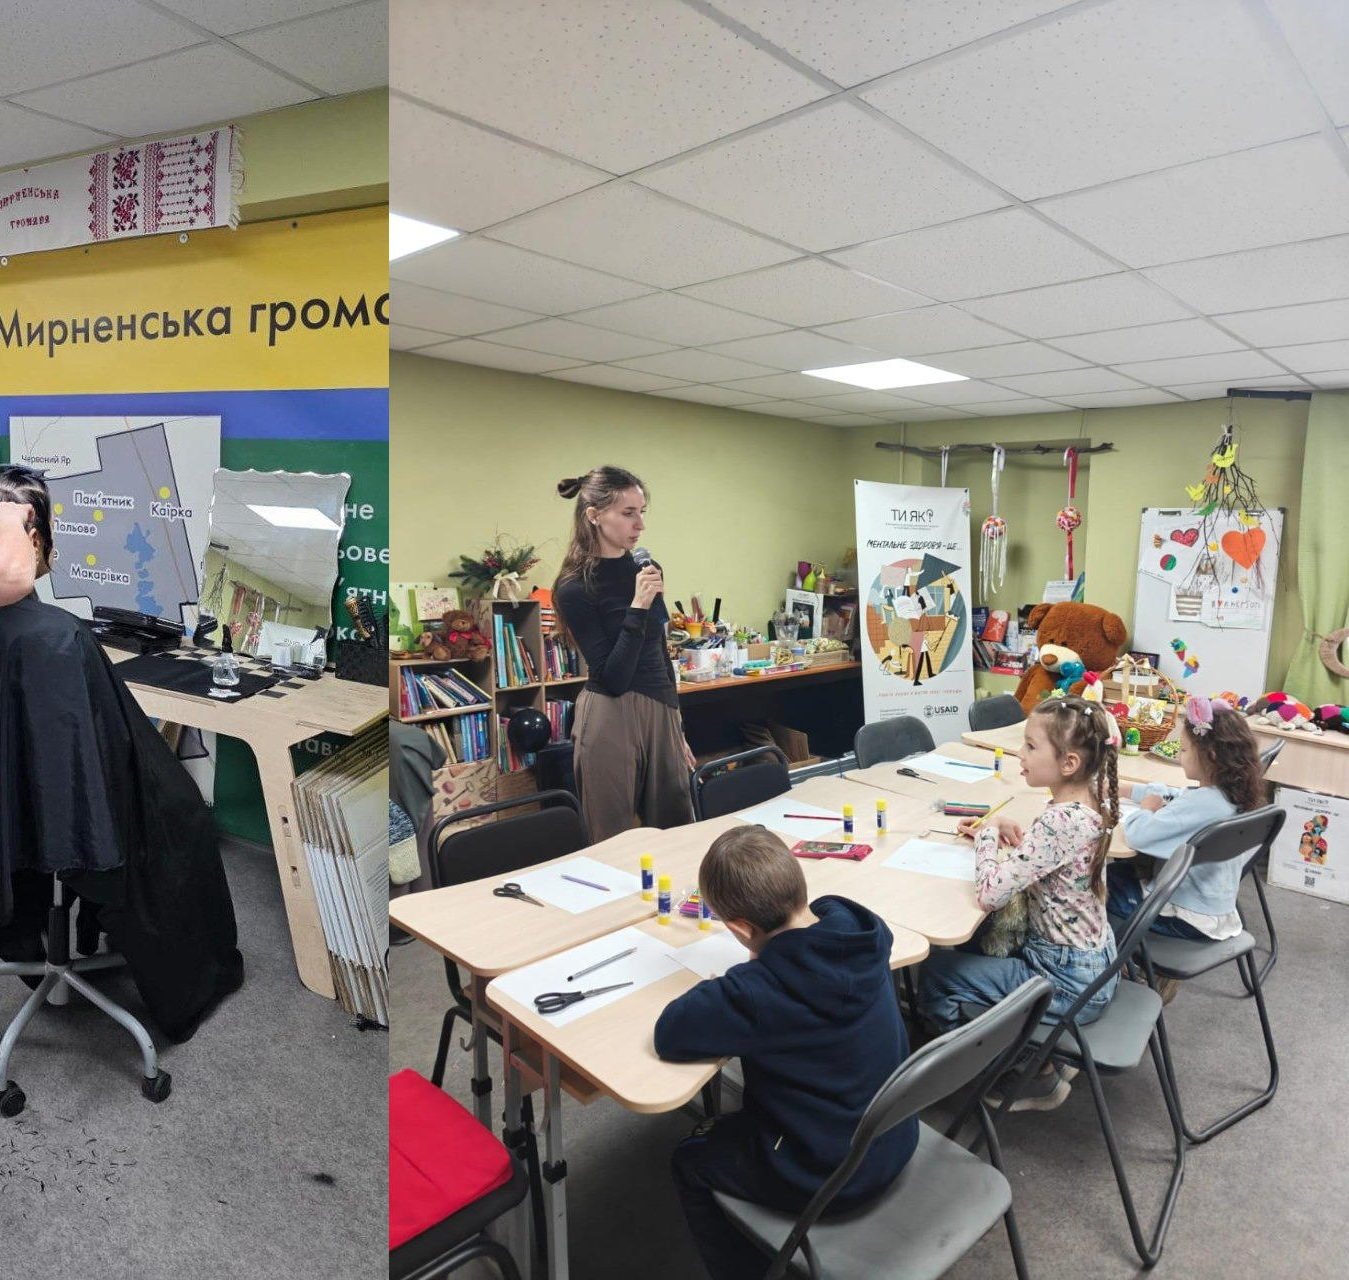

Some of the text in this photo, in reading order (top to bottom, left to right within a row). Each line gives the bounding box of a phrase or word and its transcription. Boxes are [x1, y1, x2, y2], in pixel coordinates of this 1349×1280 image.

[60, 455, 71, 465] Яр
[151, 503, 193, 520] Каїрка
[890, 508, 934, 523] ТИ ЯК?
[867, 539, 907, 550] МЕНТАЛЬНЕ
[71, 565, 129, 583] Макарівка
[934, 705, 959, 714] USAID
